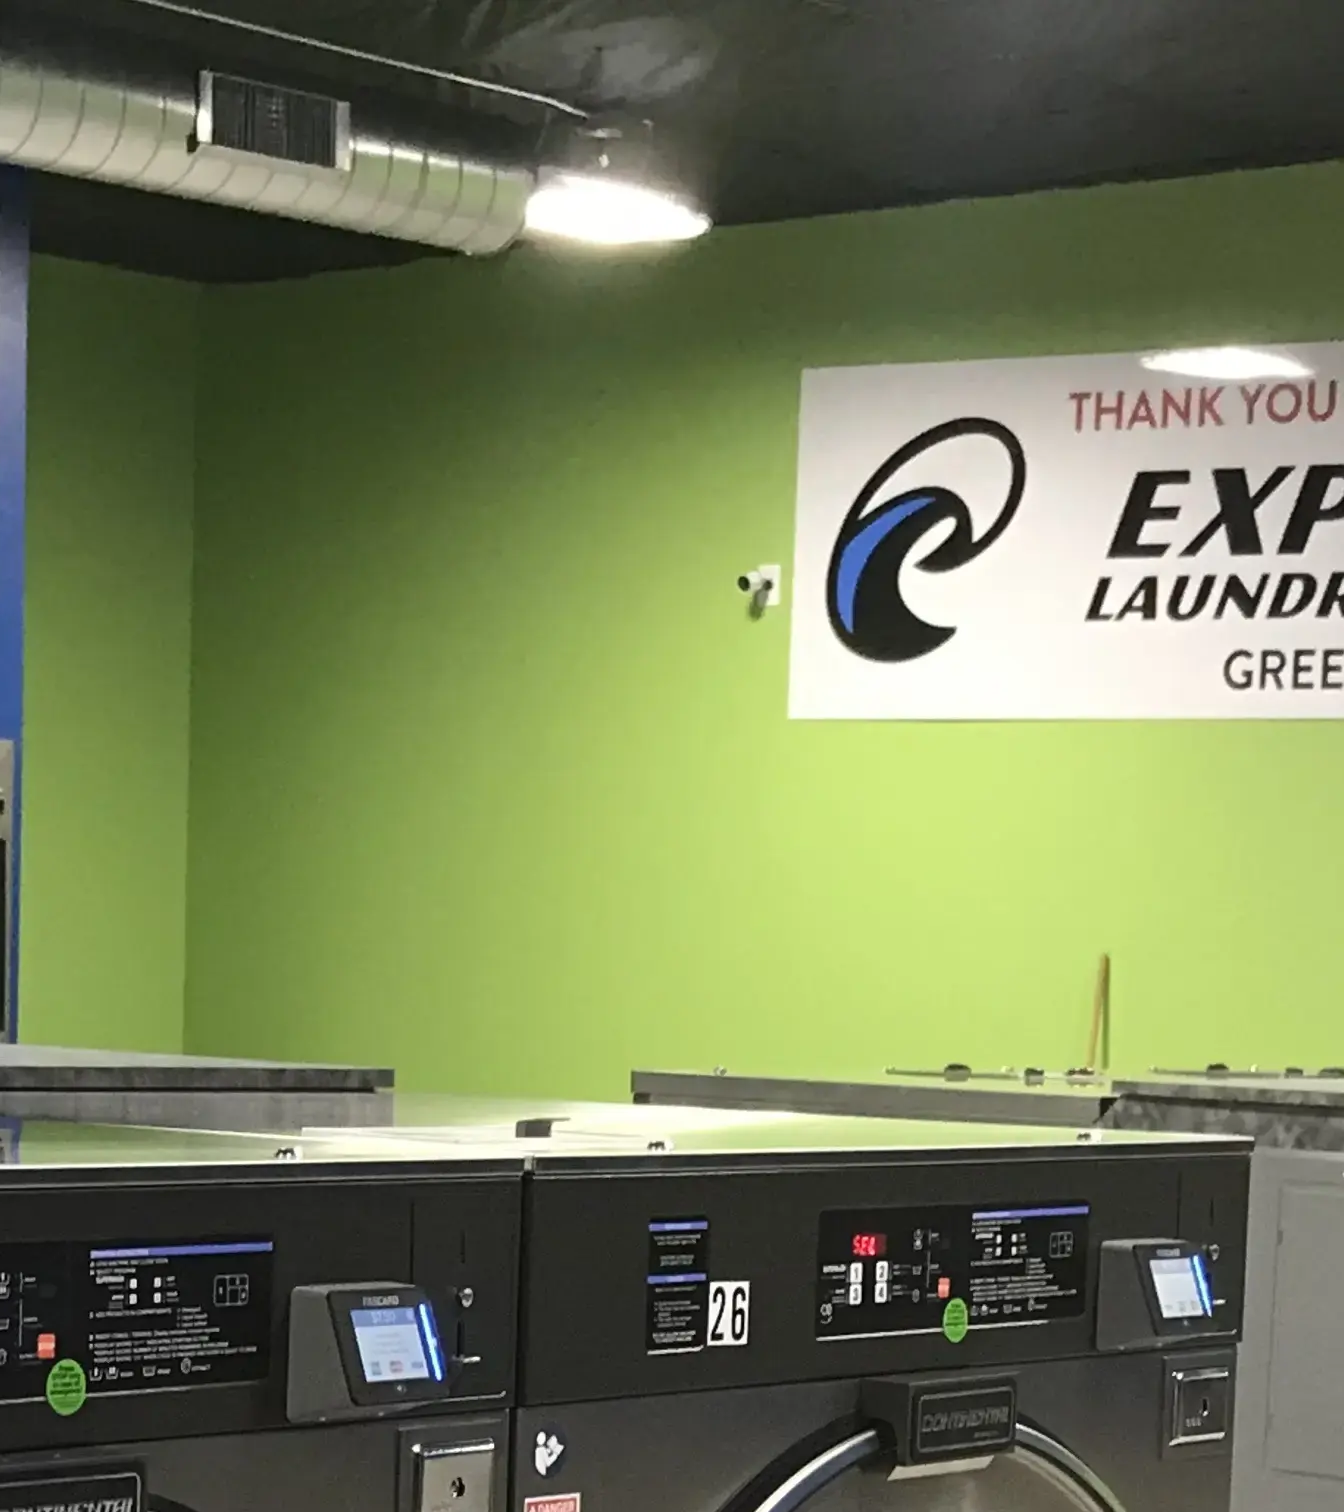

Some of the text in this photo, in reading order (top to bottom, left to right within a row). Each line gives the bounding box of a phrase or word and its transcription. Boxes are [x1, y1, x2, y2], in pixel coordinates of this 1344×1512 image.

[1069, 387, 1225, 433] THANK
[1241, 382, 1337, 424] YOU
[710, 1285, 747, 1341] 26
